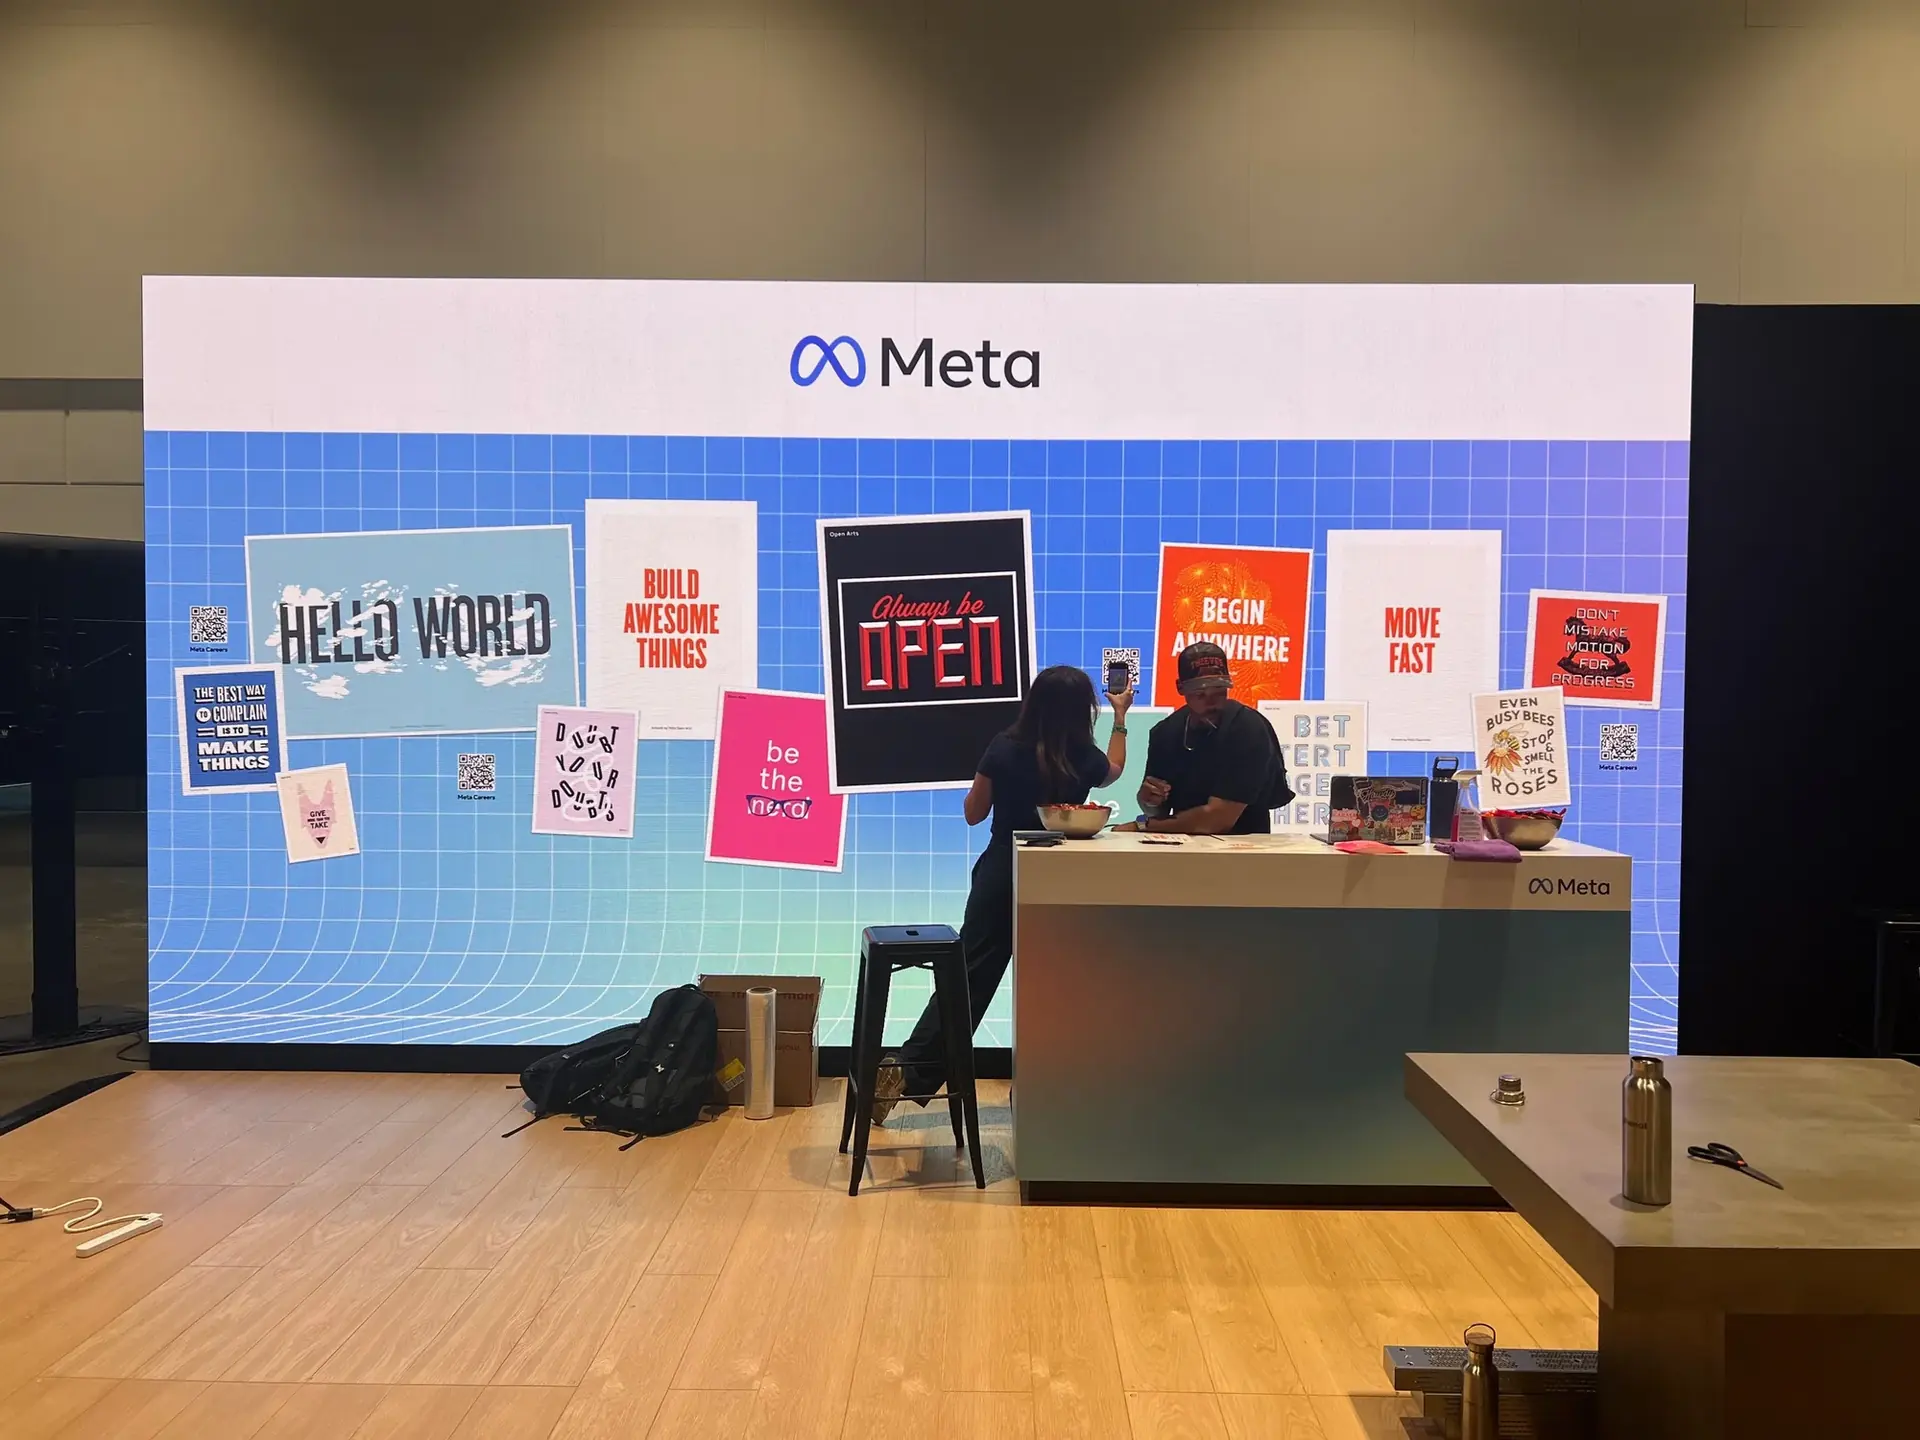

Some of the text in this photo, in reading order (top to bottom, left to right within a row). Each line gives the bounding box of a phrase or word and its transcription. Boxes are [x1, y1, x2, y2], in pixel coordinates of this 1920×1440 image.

[881, 337, 1040, 388] Meta
[644, 568, 699, 599] BUILD
[623, 602, 720, 634] AWESOME
[872, 591, 985, 627] Always be
[1202, 596, 1265, 625] BEGIN
[1576, 607, 1620, 621] DON'T
[279, 593, 551, 664] HELLO WORLD
[1385, 607, 1441, 638] MOVE
[1564, 624, 1629, 638] MISTAKE
[636, 637, 707, 669] THINGS
[858, 616, 1002, 691] OPEN
[1389, 642, 1436, 673] FAST
[1566, 641, 1625, 654] MOTION
[1579, 658, 1610, 670] FOR
[1551, 673, 1635, 689] PROGRESS
[195, 684, 267, 702] THE BEST WAY
[1499, 698, 1538, 709] EVEN
[213, 704, 268, 722] COMPLAIN
[1486, 710, 1555, 732] BUSY BEES
[222, 726, 244, 735] IS TO
[1294, 714, 1351, 738] BET
[198, 740, 269, 755] MAKE
[1521, 729, 1555, 749] STOP
[199, 755, 270, 771] THINGS
[767, 740, 800, 764] be
[1524, 752, 1555, 766] SMELL
[555, 754, 619, 789] YOUR
[760, 767, 803, 792] the
[1523, 767, 1544, 775] THE
[1491, 769, 1558, 796] ROSES
[551, 780, 615, 822] DOUBTS
[747, 797, 811, 819] nerd
[309, 809, 327, 817] GIVE
[310, 821, 329, 829] TAKE
[1558, 878, 1610, 895] Meta
